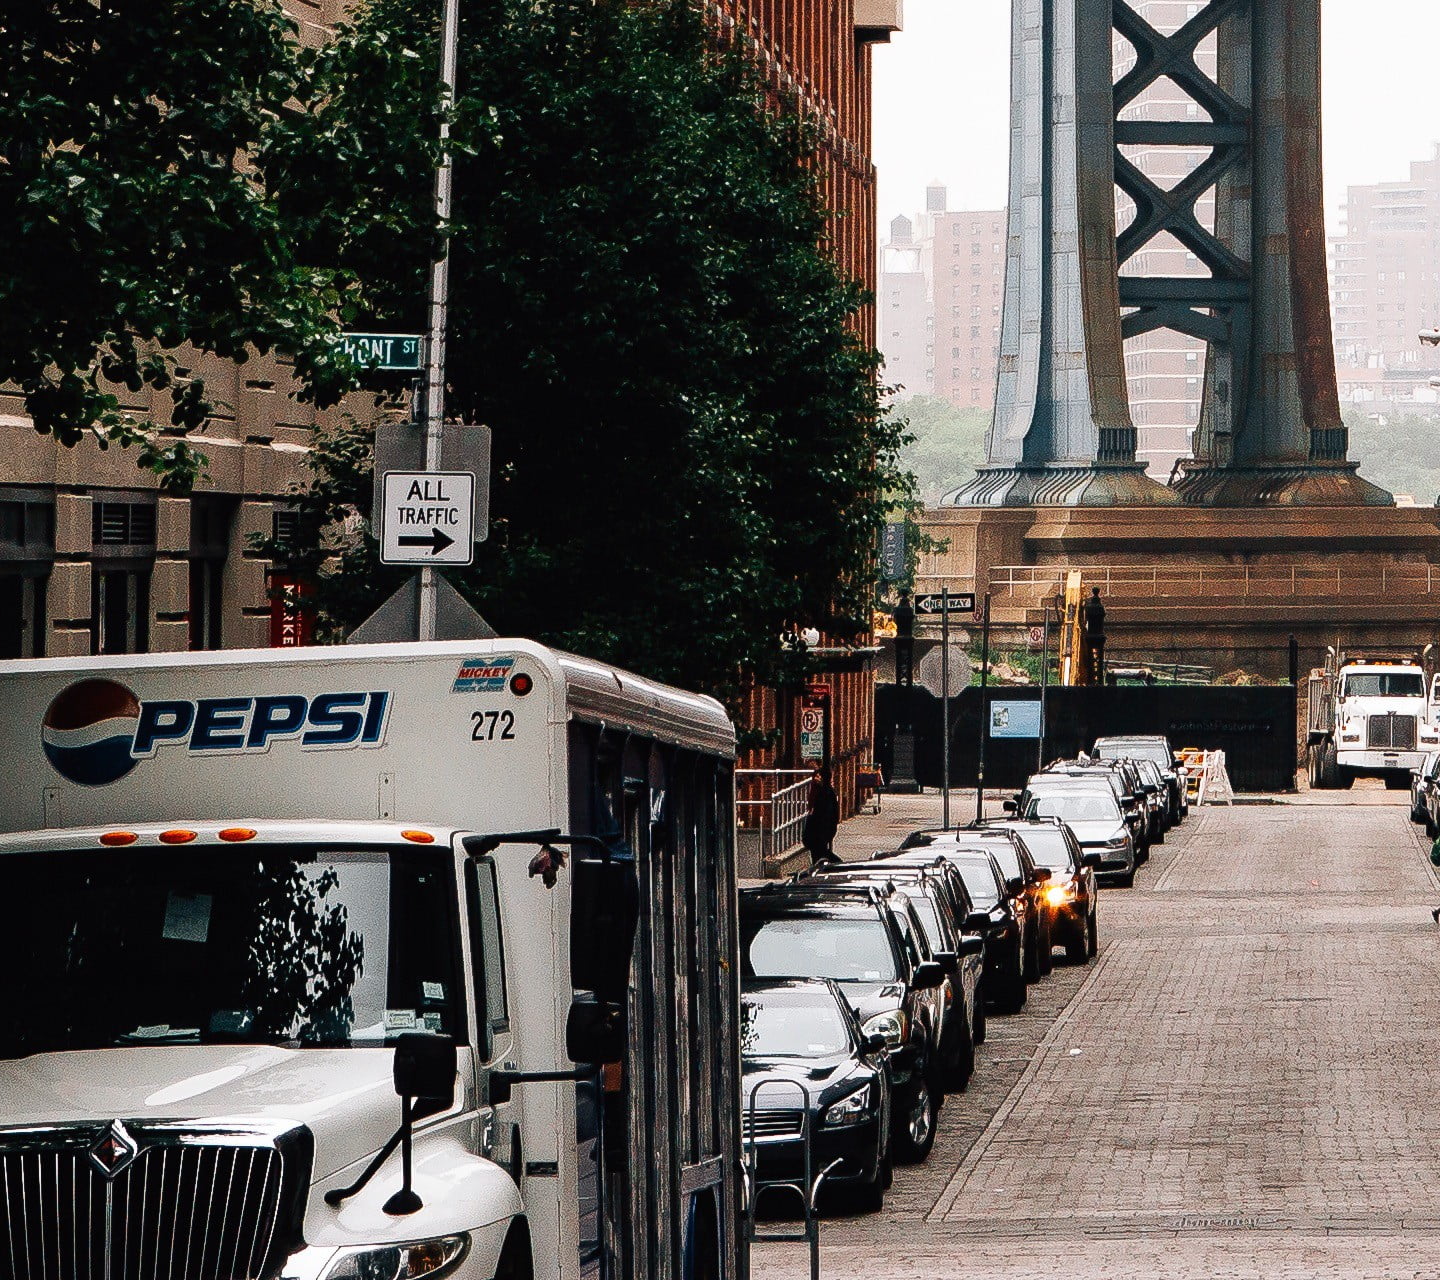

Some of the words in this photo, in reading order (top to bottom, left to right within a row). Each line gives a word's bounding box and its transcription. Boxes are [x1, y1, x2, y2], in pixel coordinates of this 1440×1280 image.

[335, 338, 394, 365] RONT
[403, 340, 415, 354] ST
[406, 480, 450, 502] ALL
[397, 506, 459, 526] TRAFFIC
[923, 598, 942, 609] ONE
[949, 598, 968, 608] WAY
[458, 667, 511, 679] MICKEY
[132, 690, 390, 756] PEPSI
[470, 709, 516, 742] 272
